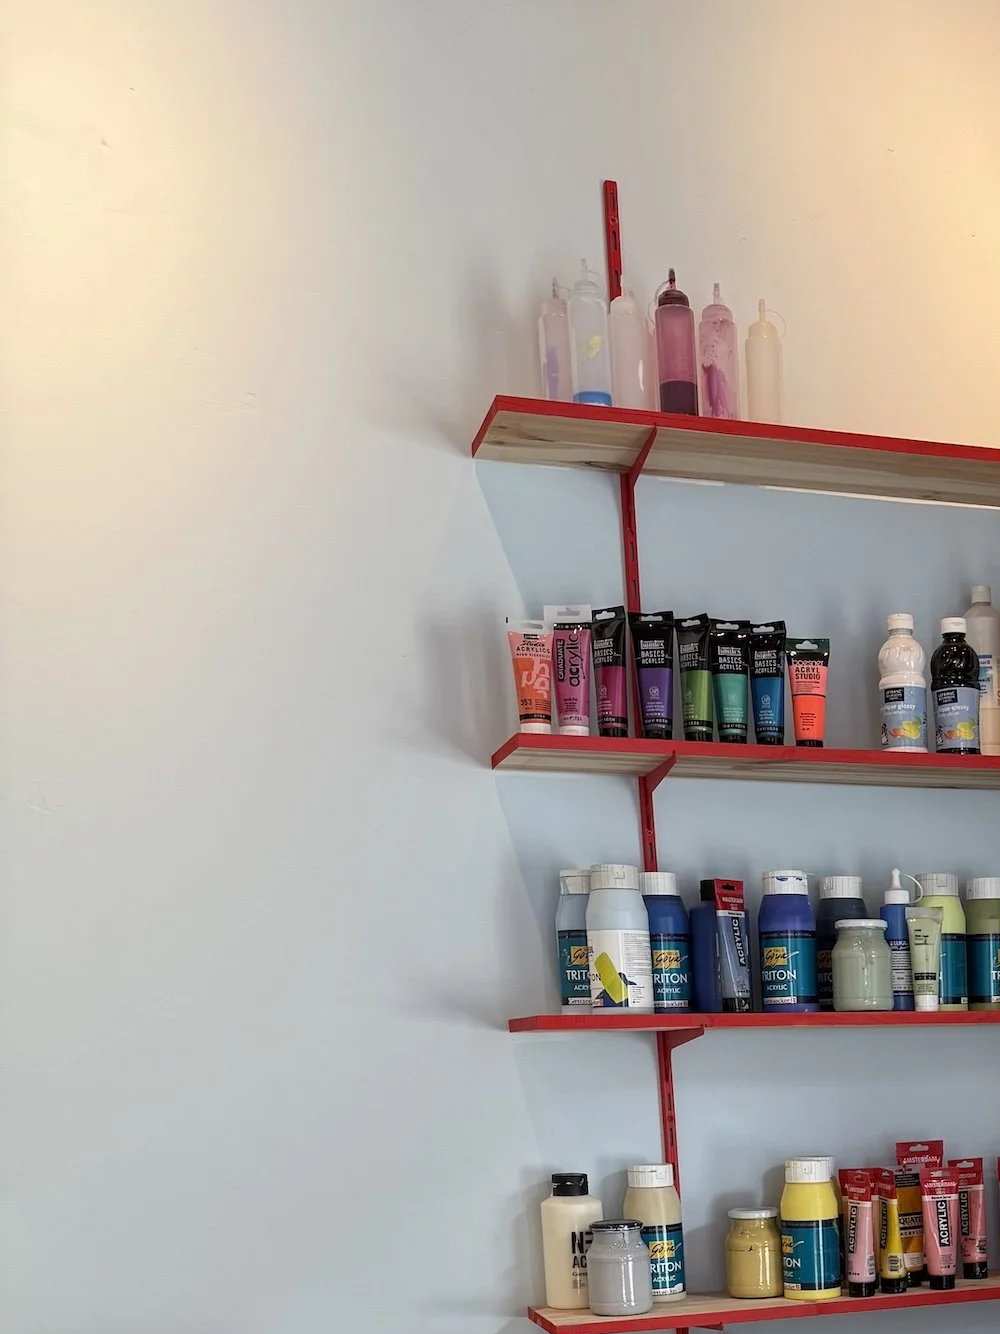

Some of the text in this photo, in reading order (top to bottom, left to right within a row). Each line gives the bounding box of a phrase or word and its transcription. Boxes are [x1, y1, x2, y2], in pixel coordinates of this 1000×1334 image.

[516, 647, 551, 655] ACRYLICS
[594, 648, 614, 658] BASICS
[640, 650, 665, 658] BASICS
[556, 639, 565, 682] GRADUATE
[566, 634, 585, 688] acrylic
[680, 653, 699, 663] BASICS
[718, 656, 743, 664] BASICS
[754, 660, 777, 668] BASICS
[795, 666, 820, 674] ACRYL
[795, 673, 821, 681] STUDIO
[520, 698, 533, 706] 353
[897, 702, 916, 711] glossy
[951, 704, 969, 712] glossy
[732, 919, 747, 966] ACRYLIC
[761, 969, 798, 981] TRITON
[903, 1155, 939, 1165] AMSTERDAM
[924, 1180, 957, 1189] AMSTERDAM
[960, 1191, 969, 1235] ACRYLIC
[880, 1201, 888, 1248] ACRYLIC
[937, 1200, 950, 1246] ACRYLIC
[848, 1206, 858, 1252] ACRYLIC
[650, 1261, 682, 1274] RITON
